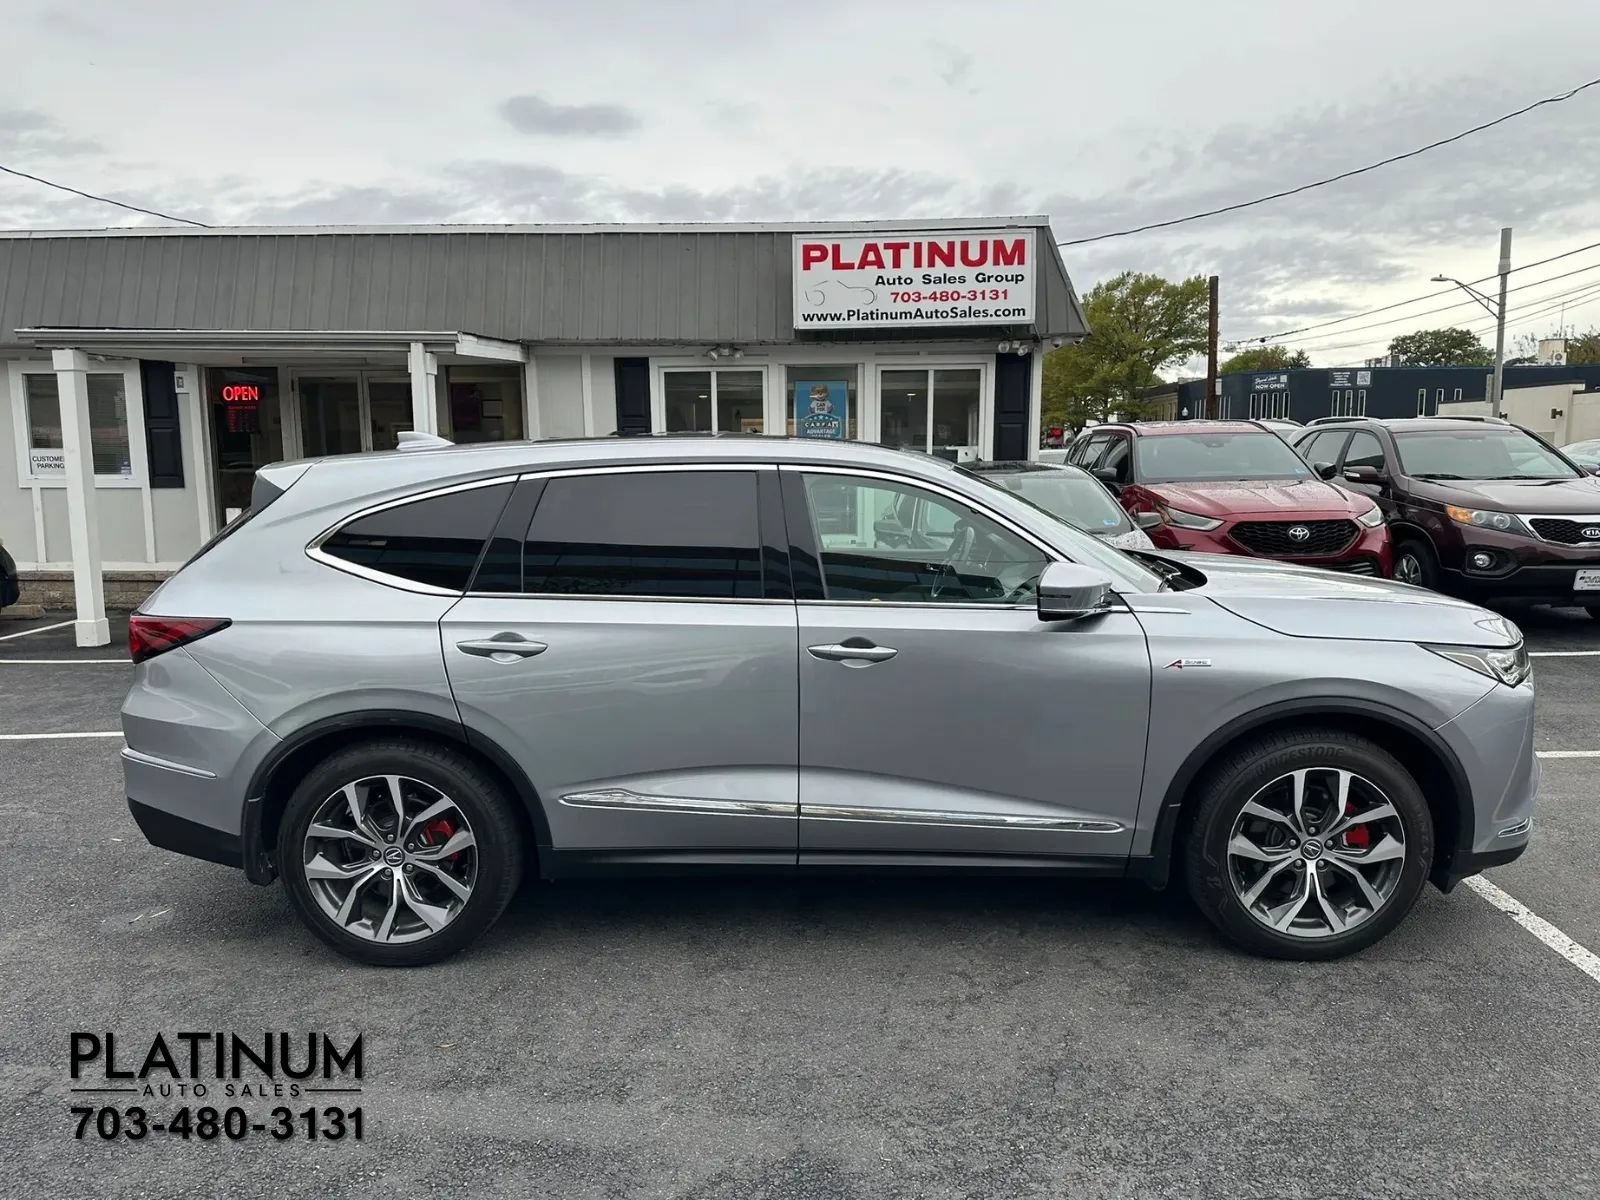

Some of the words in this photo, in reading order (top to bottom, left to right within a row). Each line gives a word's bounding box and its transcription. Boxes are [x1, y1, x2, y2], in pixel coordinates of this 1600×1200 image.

[802, 239, 1025, 271] PLATINUM
[875, 275, 913, 286] Auto
[922, 273, 966, 285] Sales
[975, 272, 1025, 285] Group
[890, 289, 1008, 303] 703-480-3131
[802, 306, 1026, 322] www.PlatinumAutoSales.com
[222, 386, 259, 401] OPEN
[1254, 746, 1345, 776] RIDGESTONE
